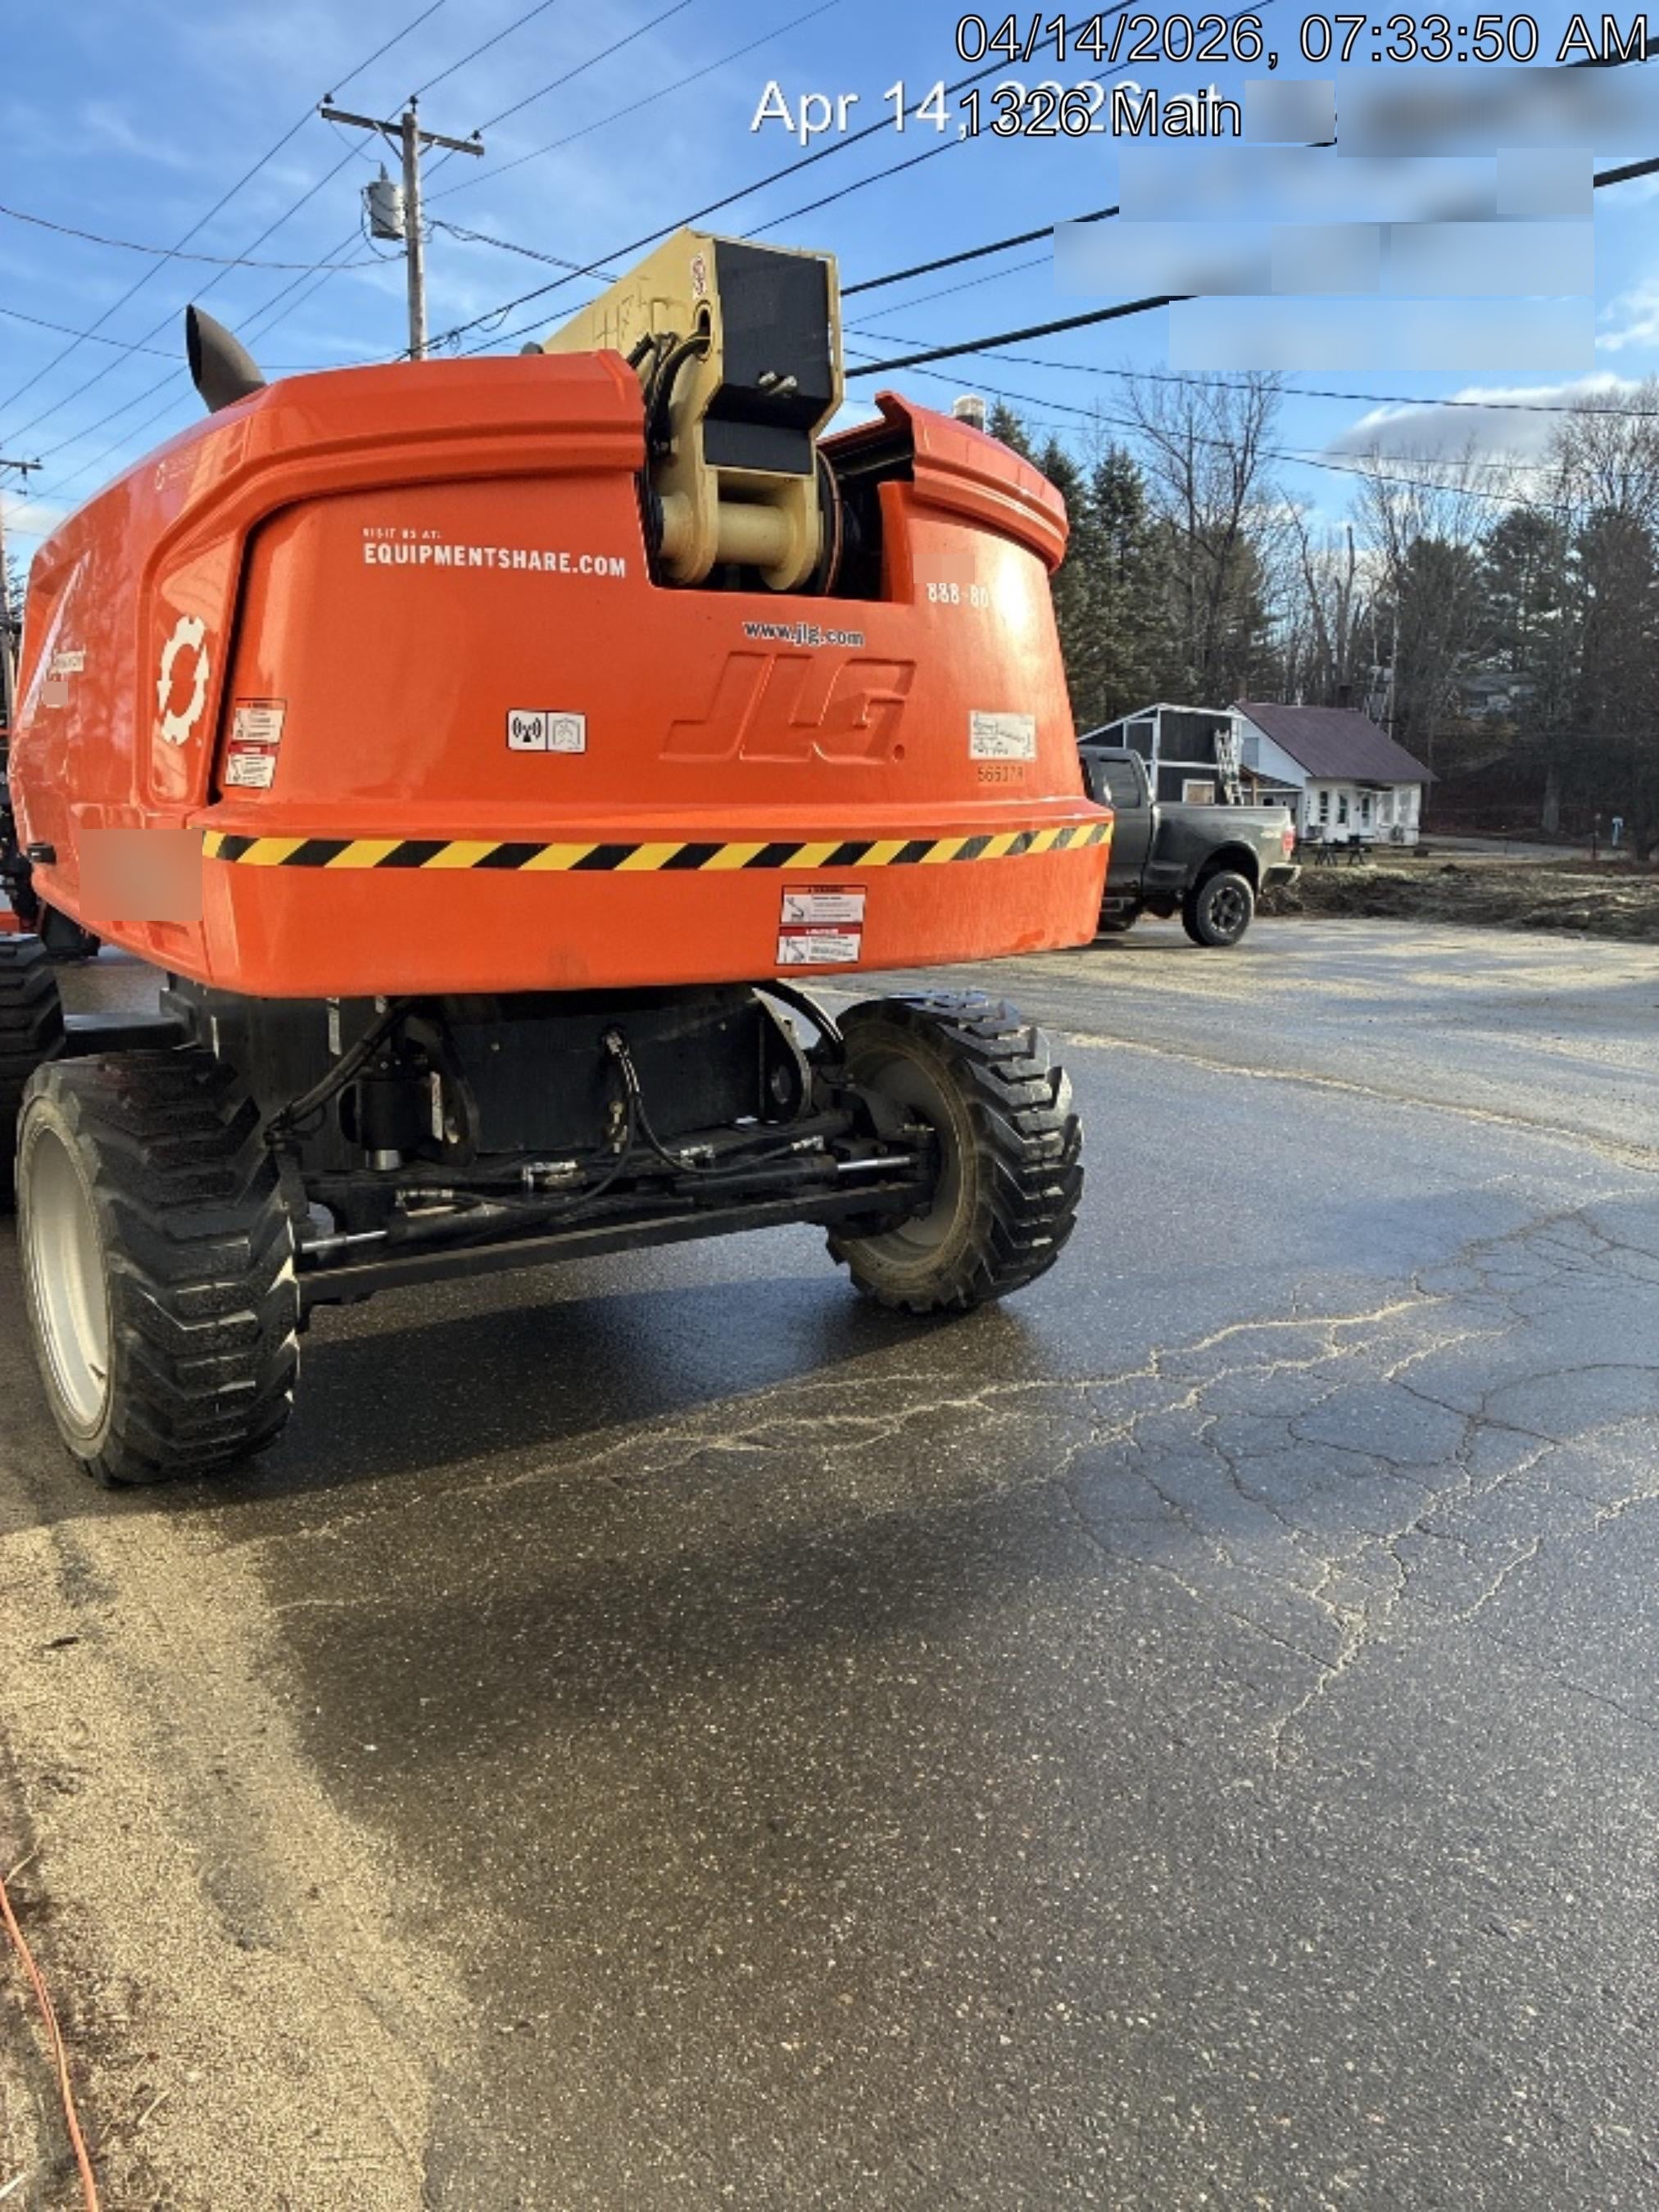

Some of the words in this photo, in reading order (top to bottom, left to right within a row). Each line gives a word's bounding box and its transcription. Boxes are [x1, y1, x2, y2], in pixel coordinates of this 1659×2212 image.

[364, 542, 626, 578] EQUIPMENTSHARE.COM
[742, 622, 864, 647] www.jlg.com
[658, 650, 918, 765] JLG
